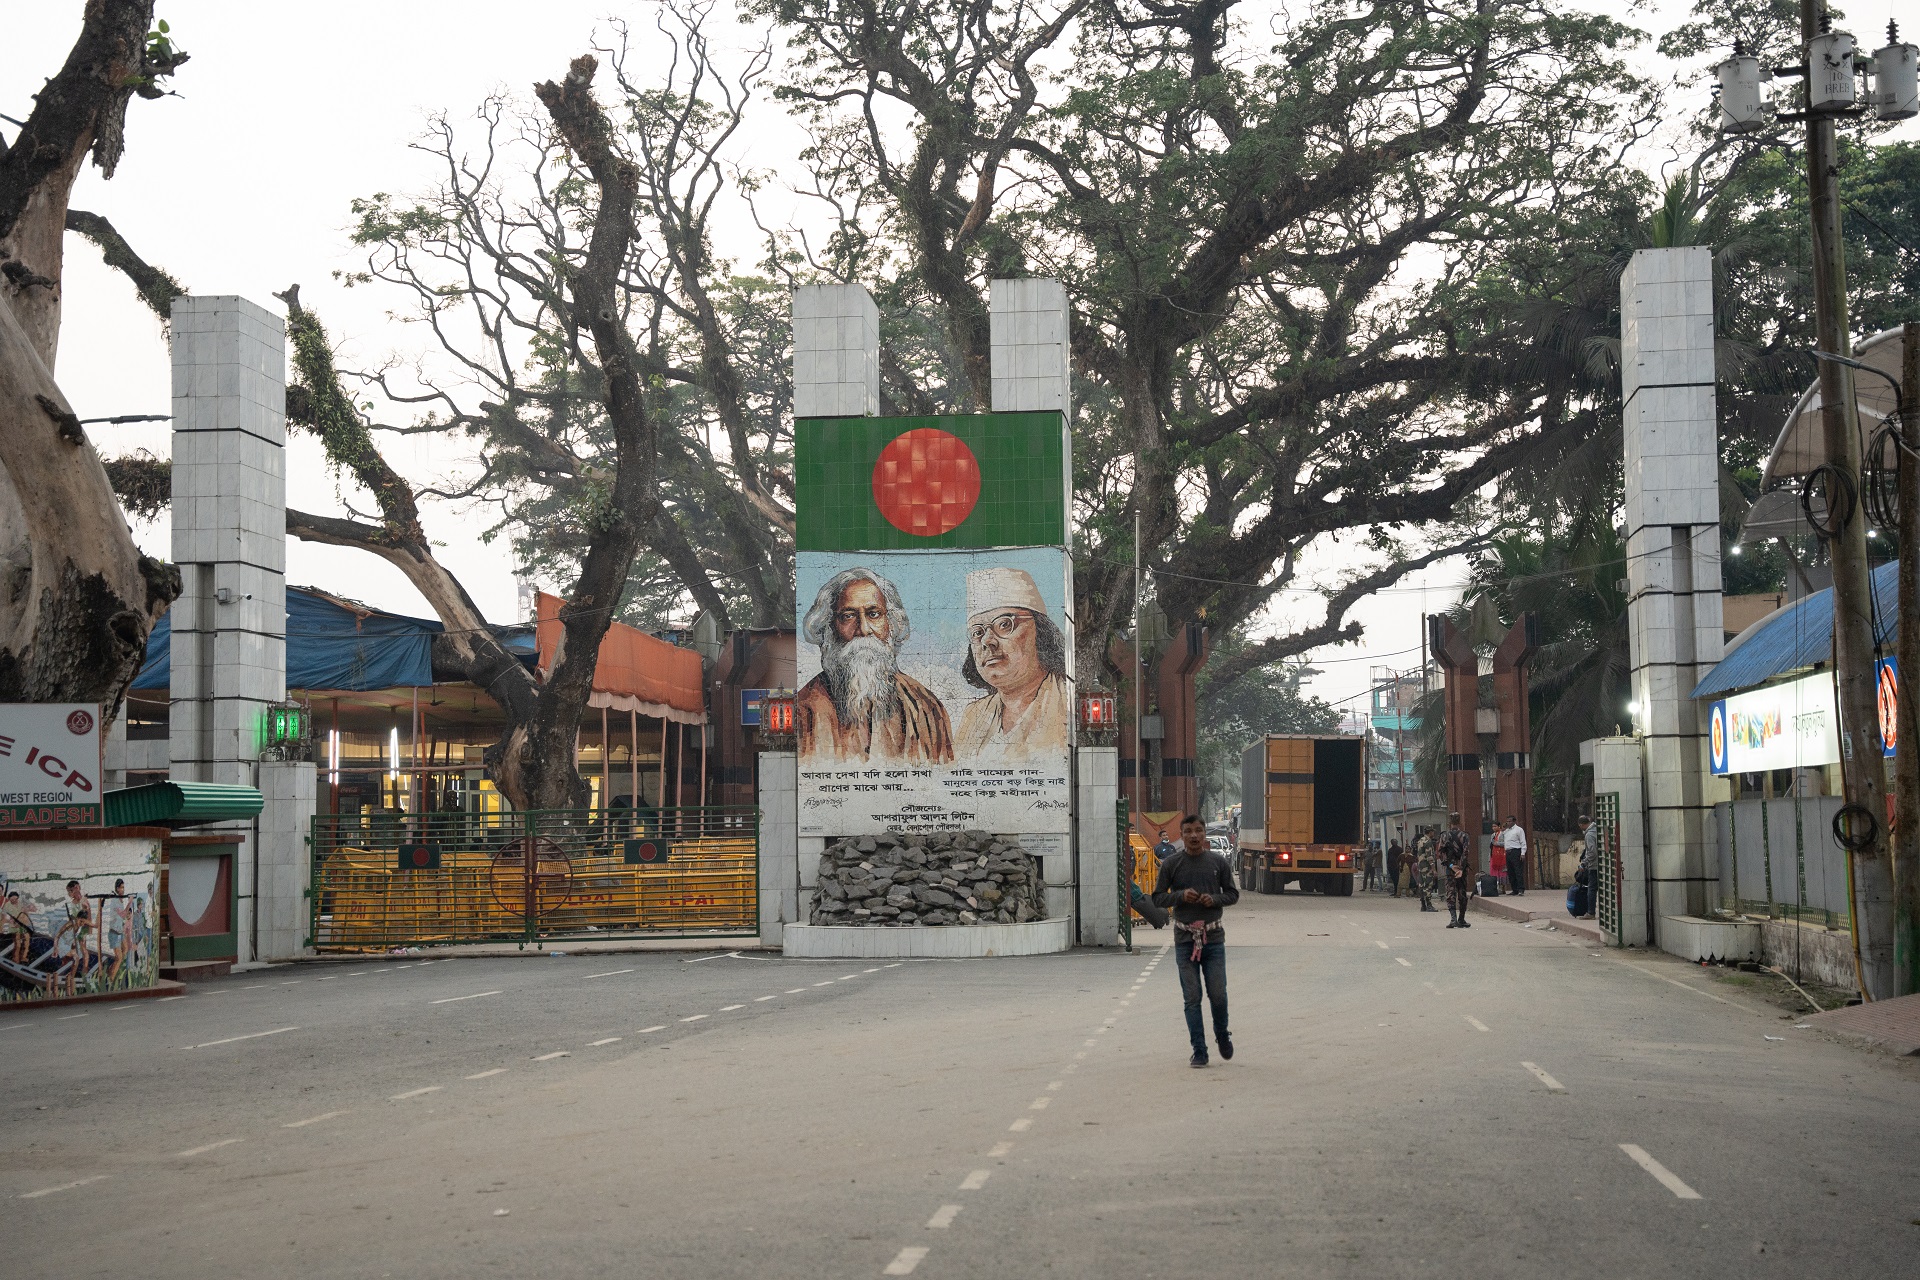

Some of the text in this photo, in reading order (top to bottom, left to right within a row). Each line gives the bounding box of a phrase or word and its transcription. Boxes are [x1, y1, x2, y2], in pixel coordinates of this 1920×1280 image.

[25, 747, 92, 792] ICP
[836, 771, 858, 779] দেখা
[863, 769, 880, 779] যদি
[819, 784, 849, 792] প্রাণের
[943, 780, 978, 788] মানুষের
[1007, 779, 1022, 787] বড়
[1026, 777, 1045, 787] কিছু
[0, 792, 72, 803] WEST REGION
[976, 789, 997, 798] কিছু
[0, 807, 95, 824] GLADESH
[871, 813, 917, 823] আশরাফুল
[951, 811, 975, 821] লিটন
